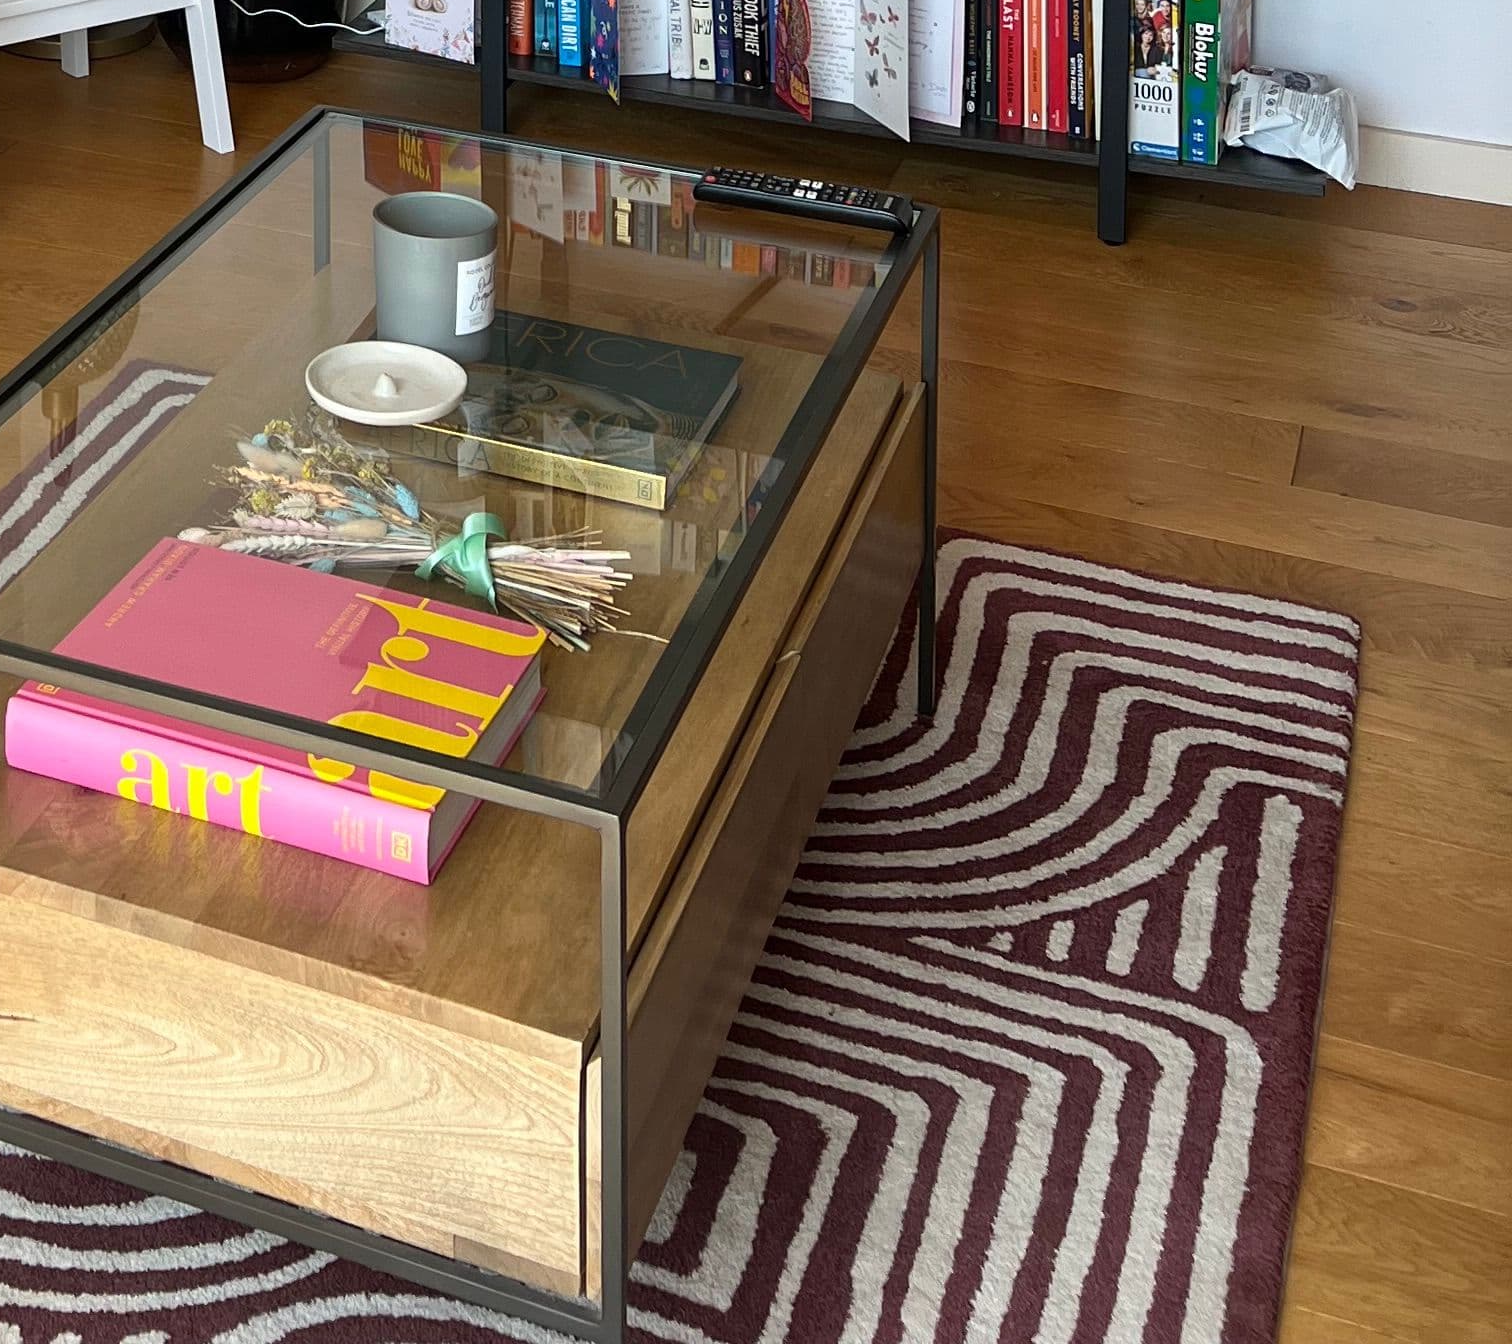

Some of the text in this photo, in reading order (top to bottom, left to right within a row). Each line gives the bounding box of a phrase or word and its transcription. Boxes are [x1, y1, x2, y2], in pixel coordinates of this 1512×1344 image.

[561, 25, 578, 52] DIRT
[733, 12, 743, 38] ZUSAK
[745, 22, 760, 57] THIEF
[1072, 9, 1080, 42] ROONEY
[1194, 21, 1216, 83] Blokus
[1076, 52, 1084, 111] CONVERSATIONS
[1133, 81, 1173, 103] 1000
[1134, 103, 1172, 115] PUZZLE
[116, 746, 273, 841] art
